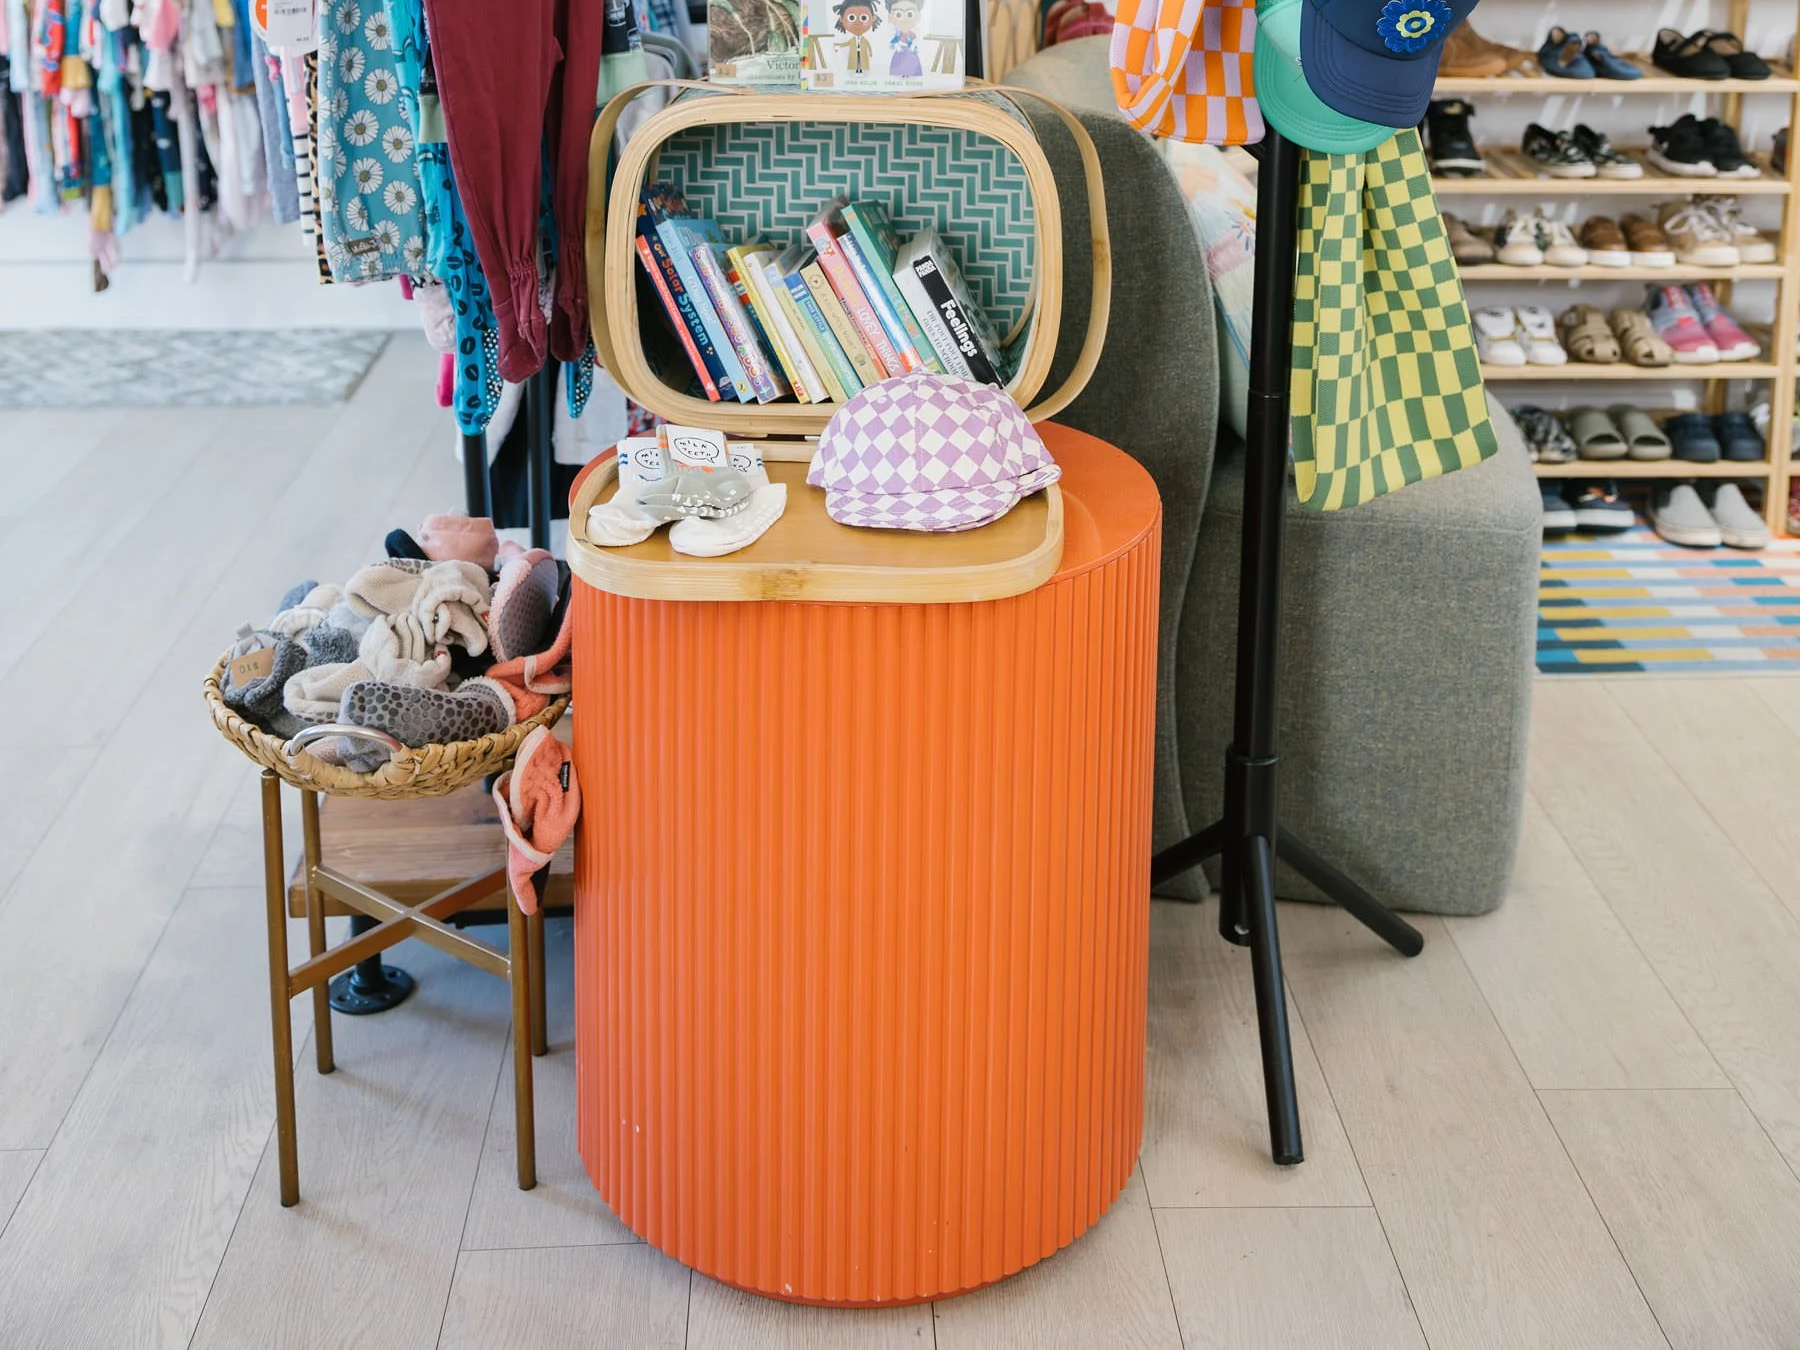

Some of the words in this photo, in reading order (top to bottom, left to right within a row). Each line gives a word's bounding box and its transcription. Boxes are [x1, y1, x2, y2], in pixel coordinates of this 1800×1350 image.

[652, 241, 667, 259] Our
[660, 256, 685, 295] Solar
[674, 291, 710, 348] System
[854, 306, 880, 337] LOVEY
[874, 337, 902, 372] THINGS
[936, 298, 982, 359] Feelings
[682, 447, 711, 457] TEETH
